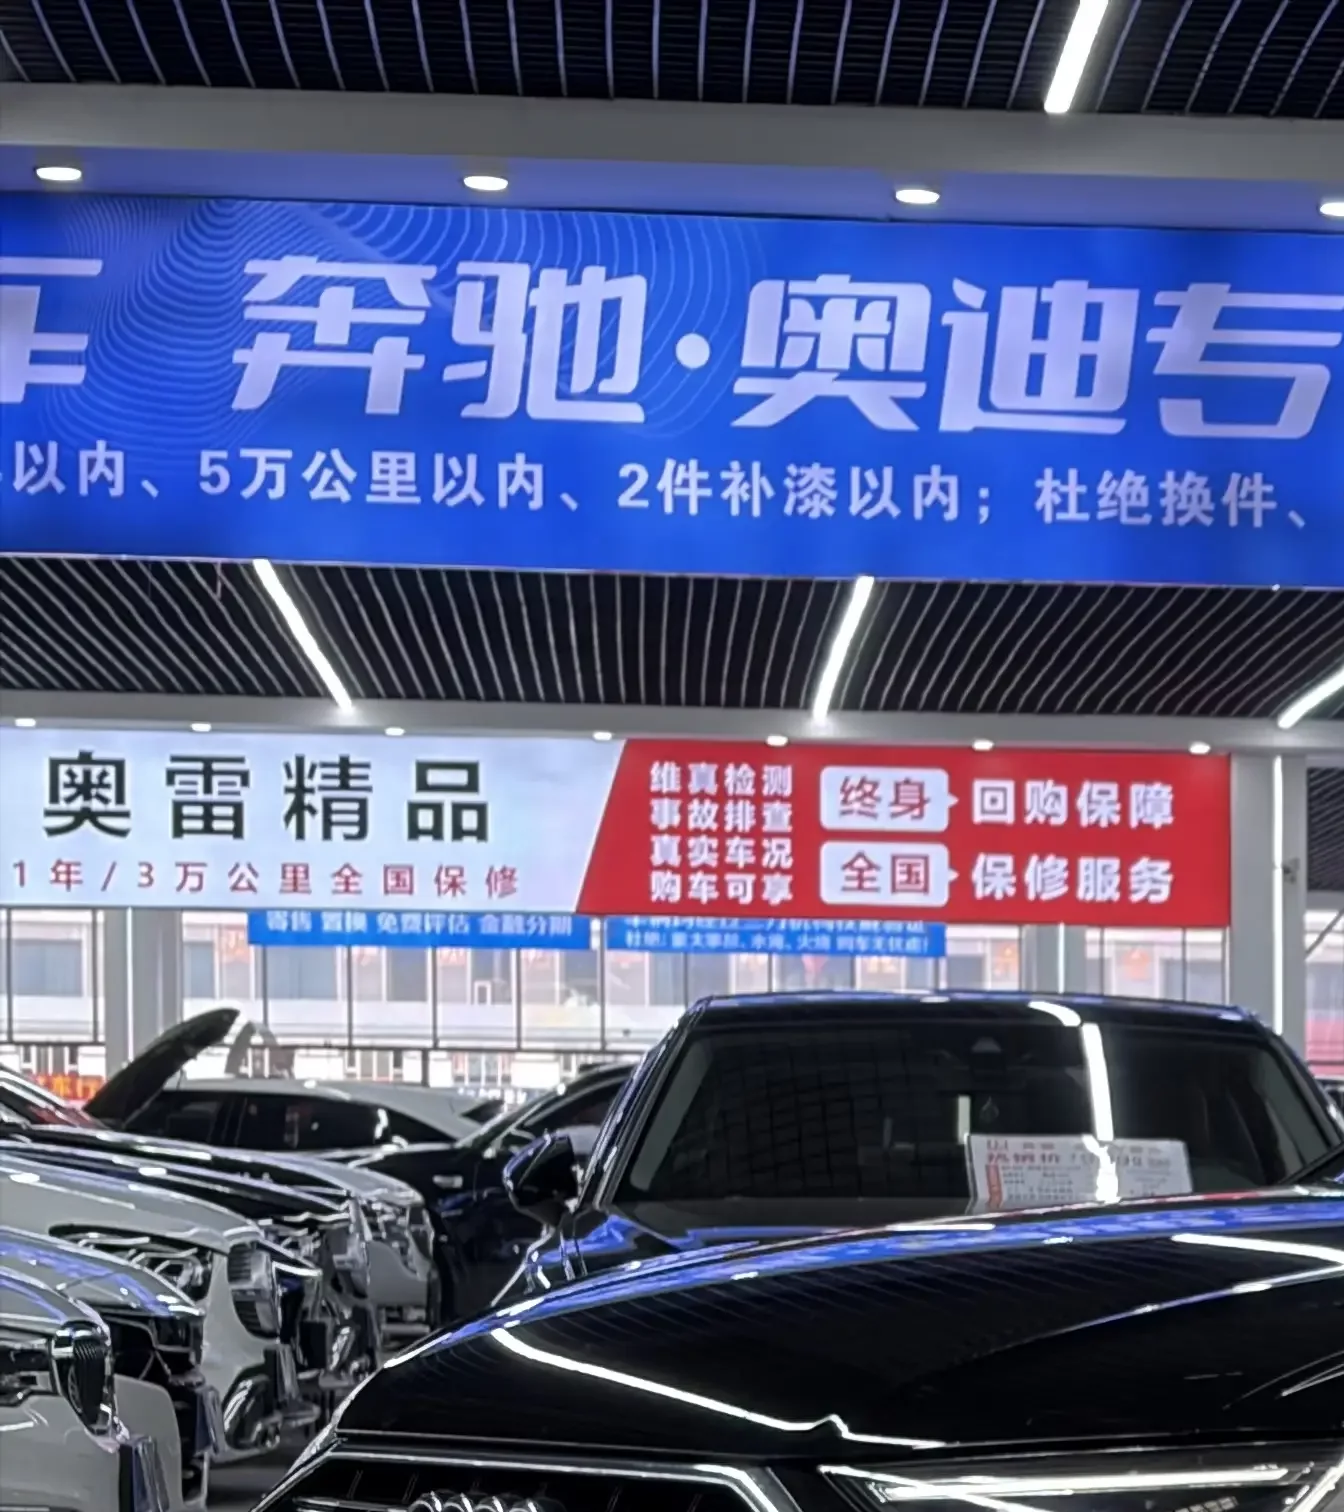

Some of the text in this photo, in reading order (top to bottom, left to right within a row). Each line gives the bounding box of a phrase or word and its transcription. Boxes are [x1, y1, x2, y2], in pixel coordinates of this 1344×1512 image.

[43, 749, 490, 843] 奥雷精品
[838, 776, 1175, 829] 终身 回购保障
[650, 797, 792, 833] 事故排查
[650, 833, 793, 870] 真实车况
[12, 860, 519, 897] 1年/3万公里全国保修
[650, 869, 793, 906] 购车可享
[840, 851, 1174, 904] 全国 保修服务
